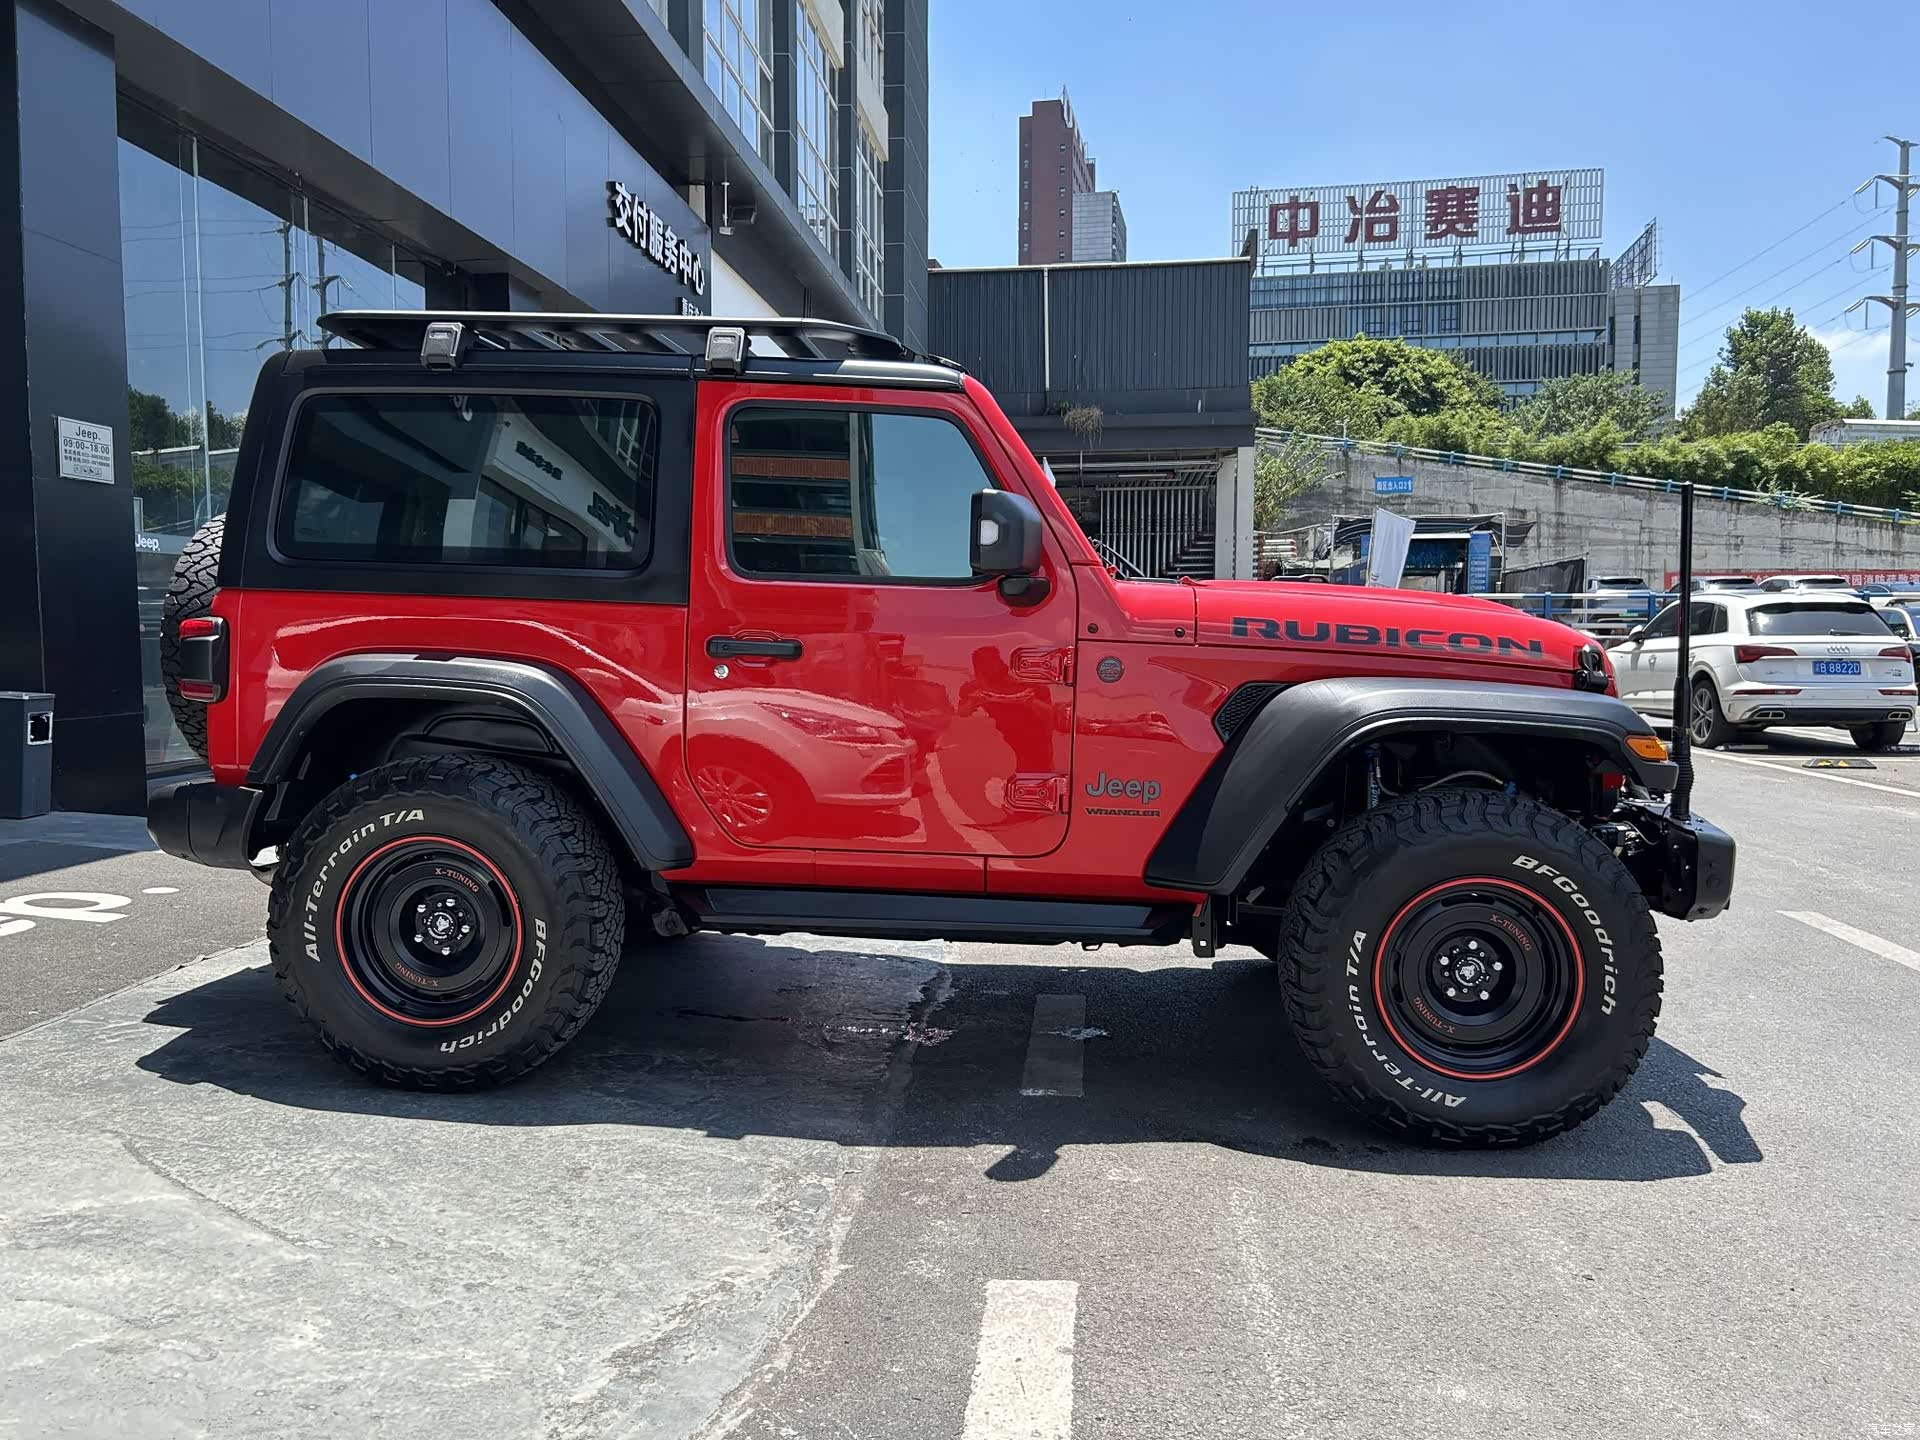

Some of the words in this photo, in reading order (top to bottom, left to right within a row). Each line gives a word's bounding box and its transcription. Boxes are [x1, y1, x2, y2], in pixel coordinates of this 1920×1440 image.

[1267, 179, 1562, 248] 中冶赛迪
[614, 181, 706, 296] 交付服务中心
[1231, 616, 1545, 658] RUBICON
[1085, 771, 1161, 805] Jeep
[1085, 807, 1161, 817] WRANGLER
[304, 821, 376, 962] All-Terrain
[379, 808, 425, 828] T/A
[435, 867, 480, 893] X-TUNING
[1346, 930, 1367, 977] T/A
[1490, 913, 1533, 952] X-TUNING
[1512, 854, 1618, 1016] BFGoodrich
[395, 962, 440, 988] X-TUNING
[439, 917, 547, 1054] BFGoodrich
[1413, 996, 1456, 1033] X-TUNING
[1347, 983, 1467, 1108] All-Terrain
